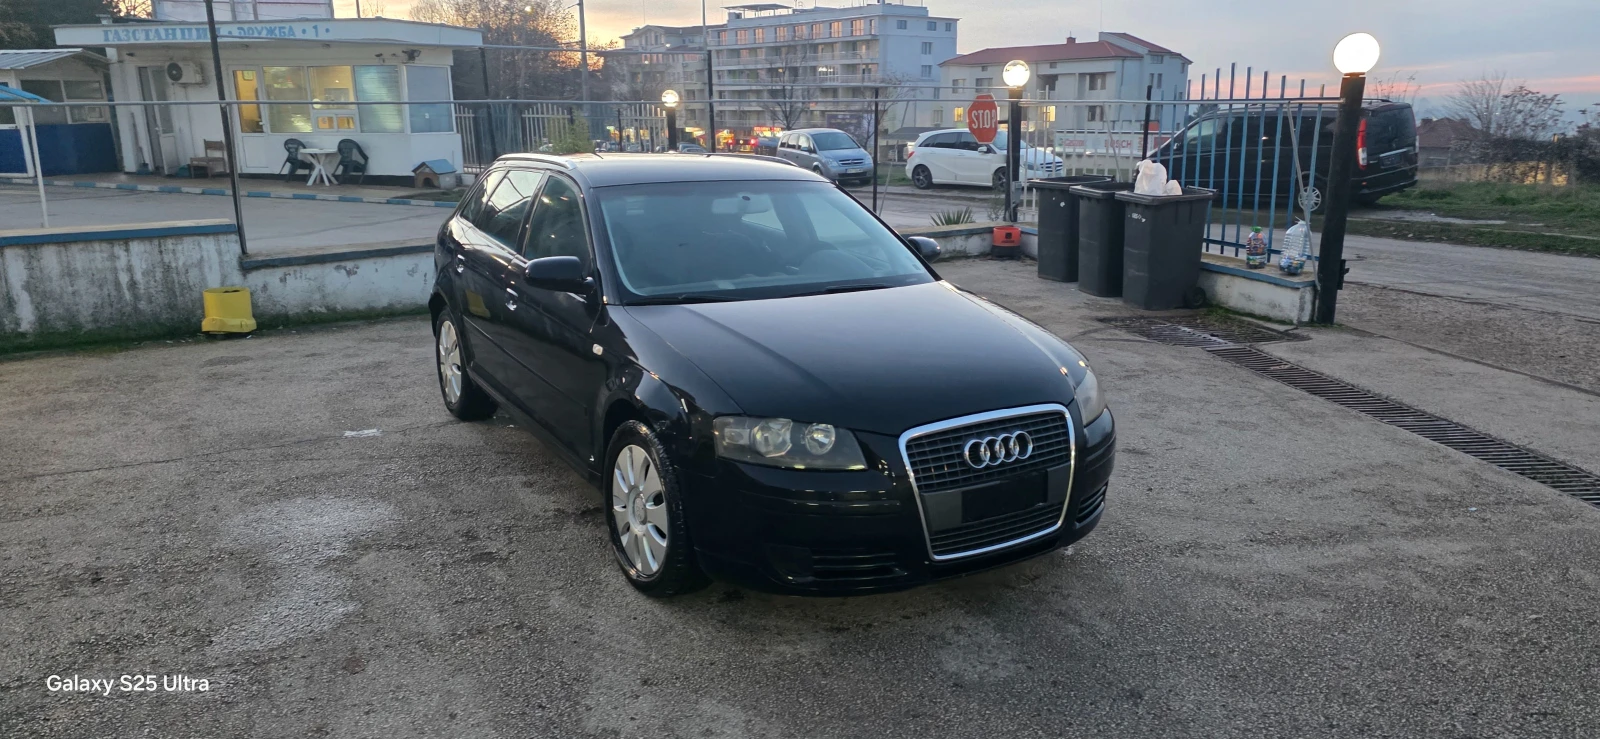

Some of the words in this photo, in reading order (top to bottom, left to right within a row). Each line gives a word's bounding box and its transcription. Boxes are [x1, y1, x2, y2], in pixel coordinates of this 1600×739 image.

[237, 25, 297, 38] ДРУЖБА
[312, 24, 319, 38] 1
[971, 109, 997, 129] STOP
